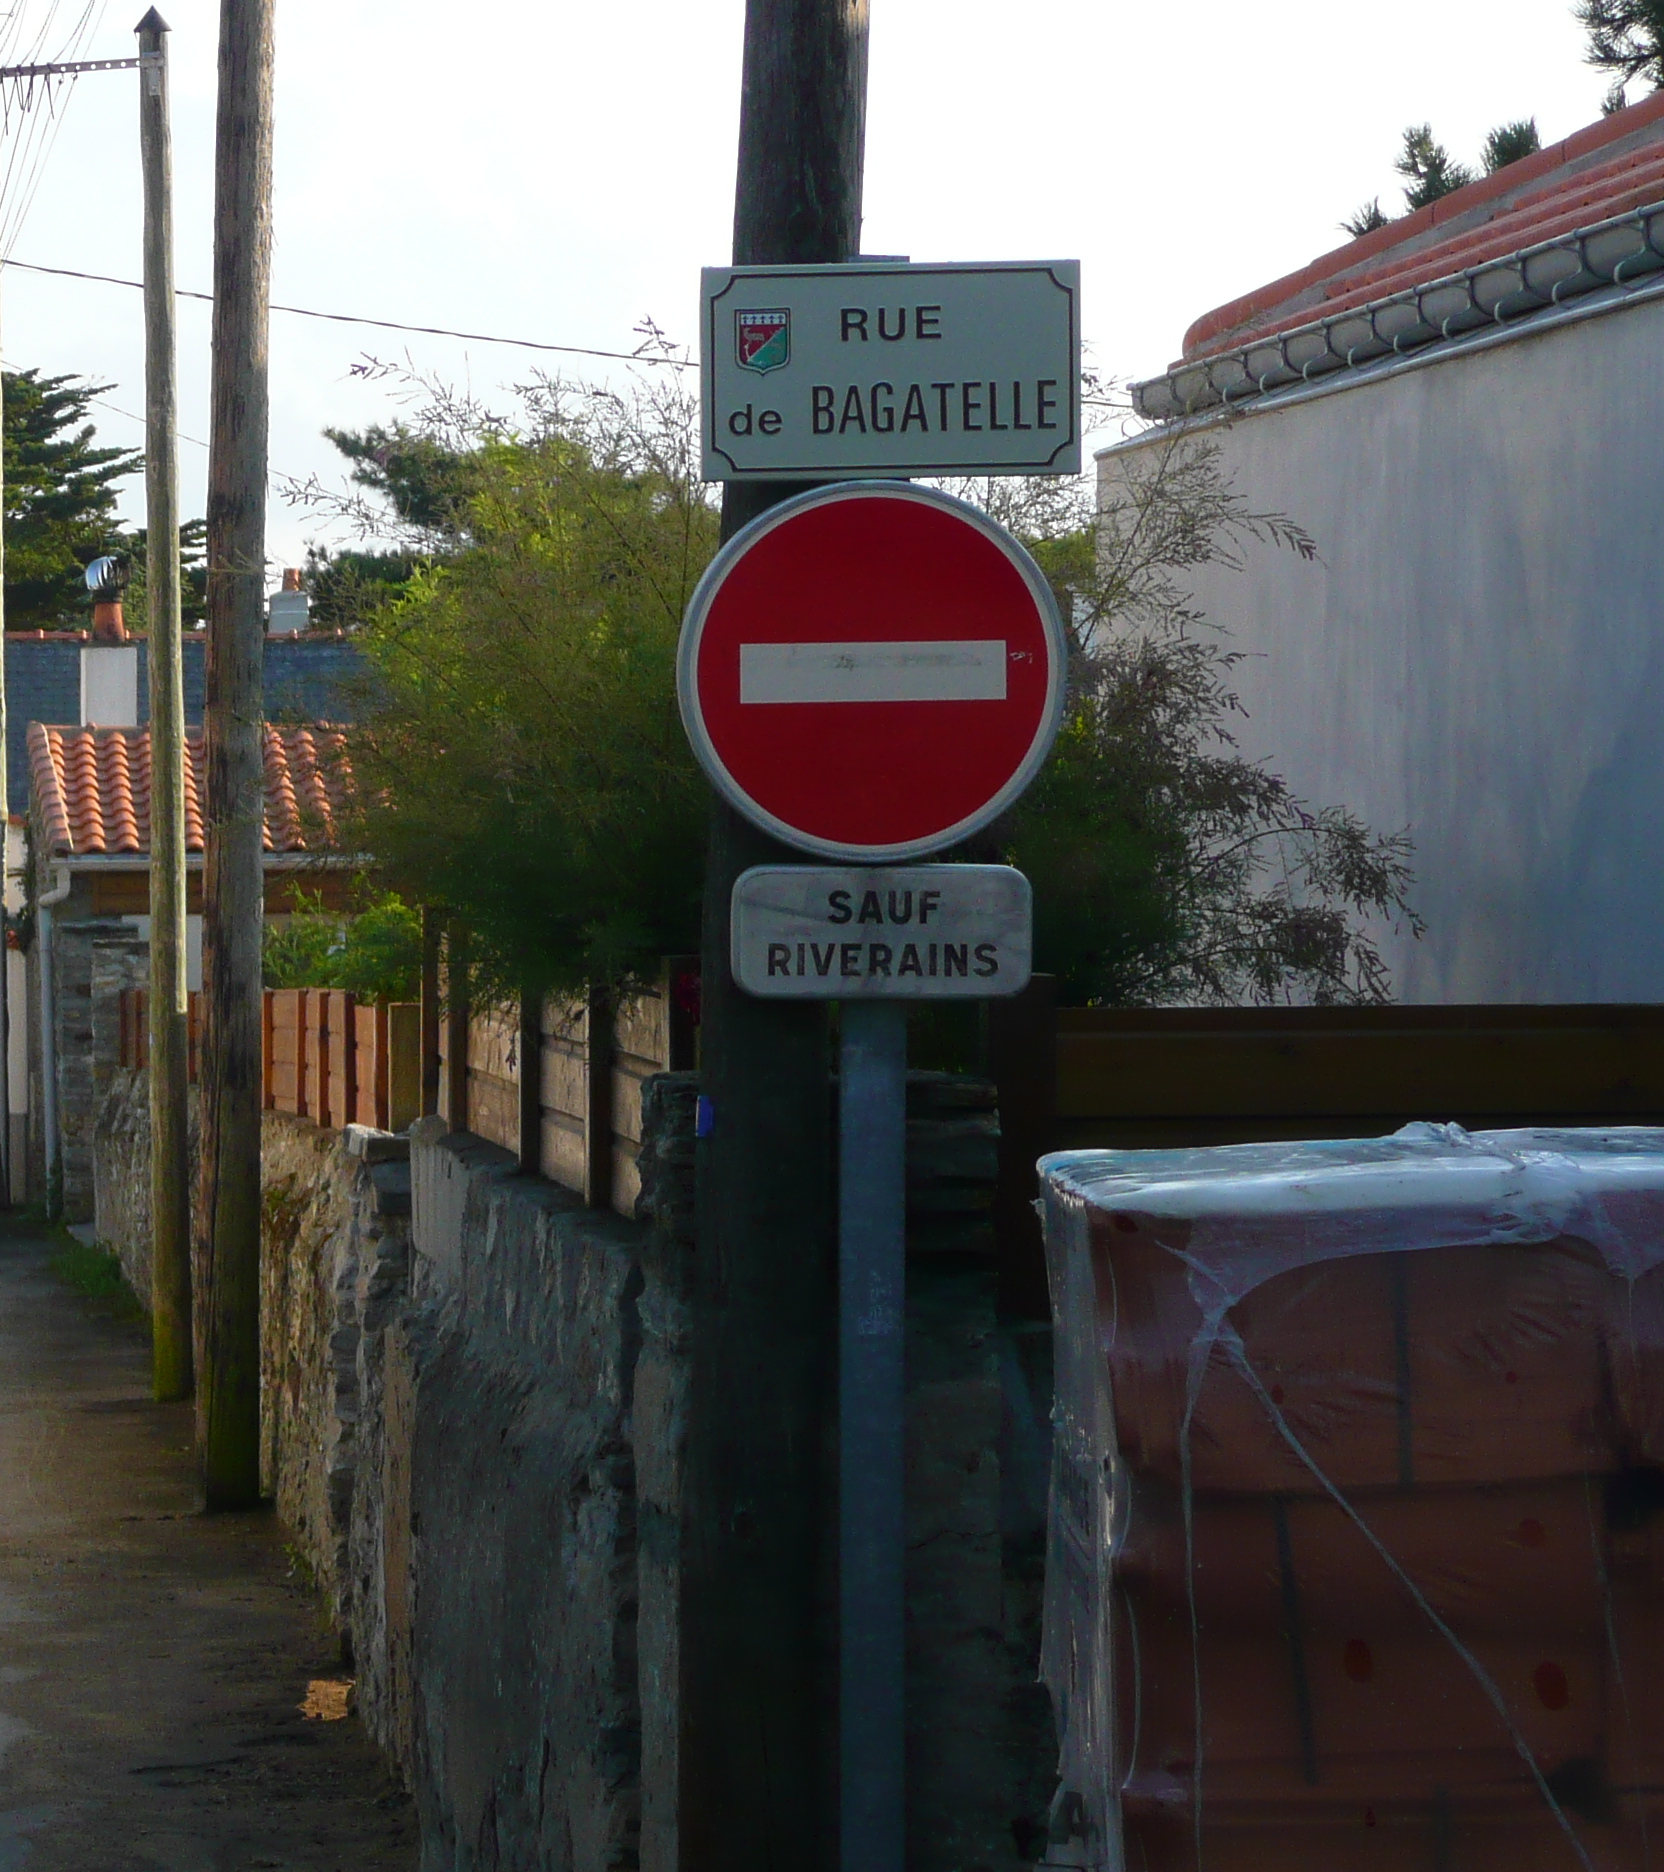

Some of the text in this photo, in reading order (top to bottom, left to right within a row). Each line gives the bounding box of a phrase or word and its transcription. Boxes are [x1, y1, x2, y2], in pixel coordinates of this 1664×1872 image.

[840, 305, 942, 342] RUE
[728, 379, 1058, 436] de BAGATELLE
[827, 889, 942, 925] SAUF
[767, 942, 999, 977] RIVERAINS
